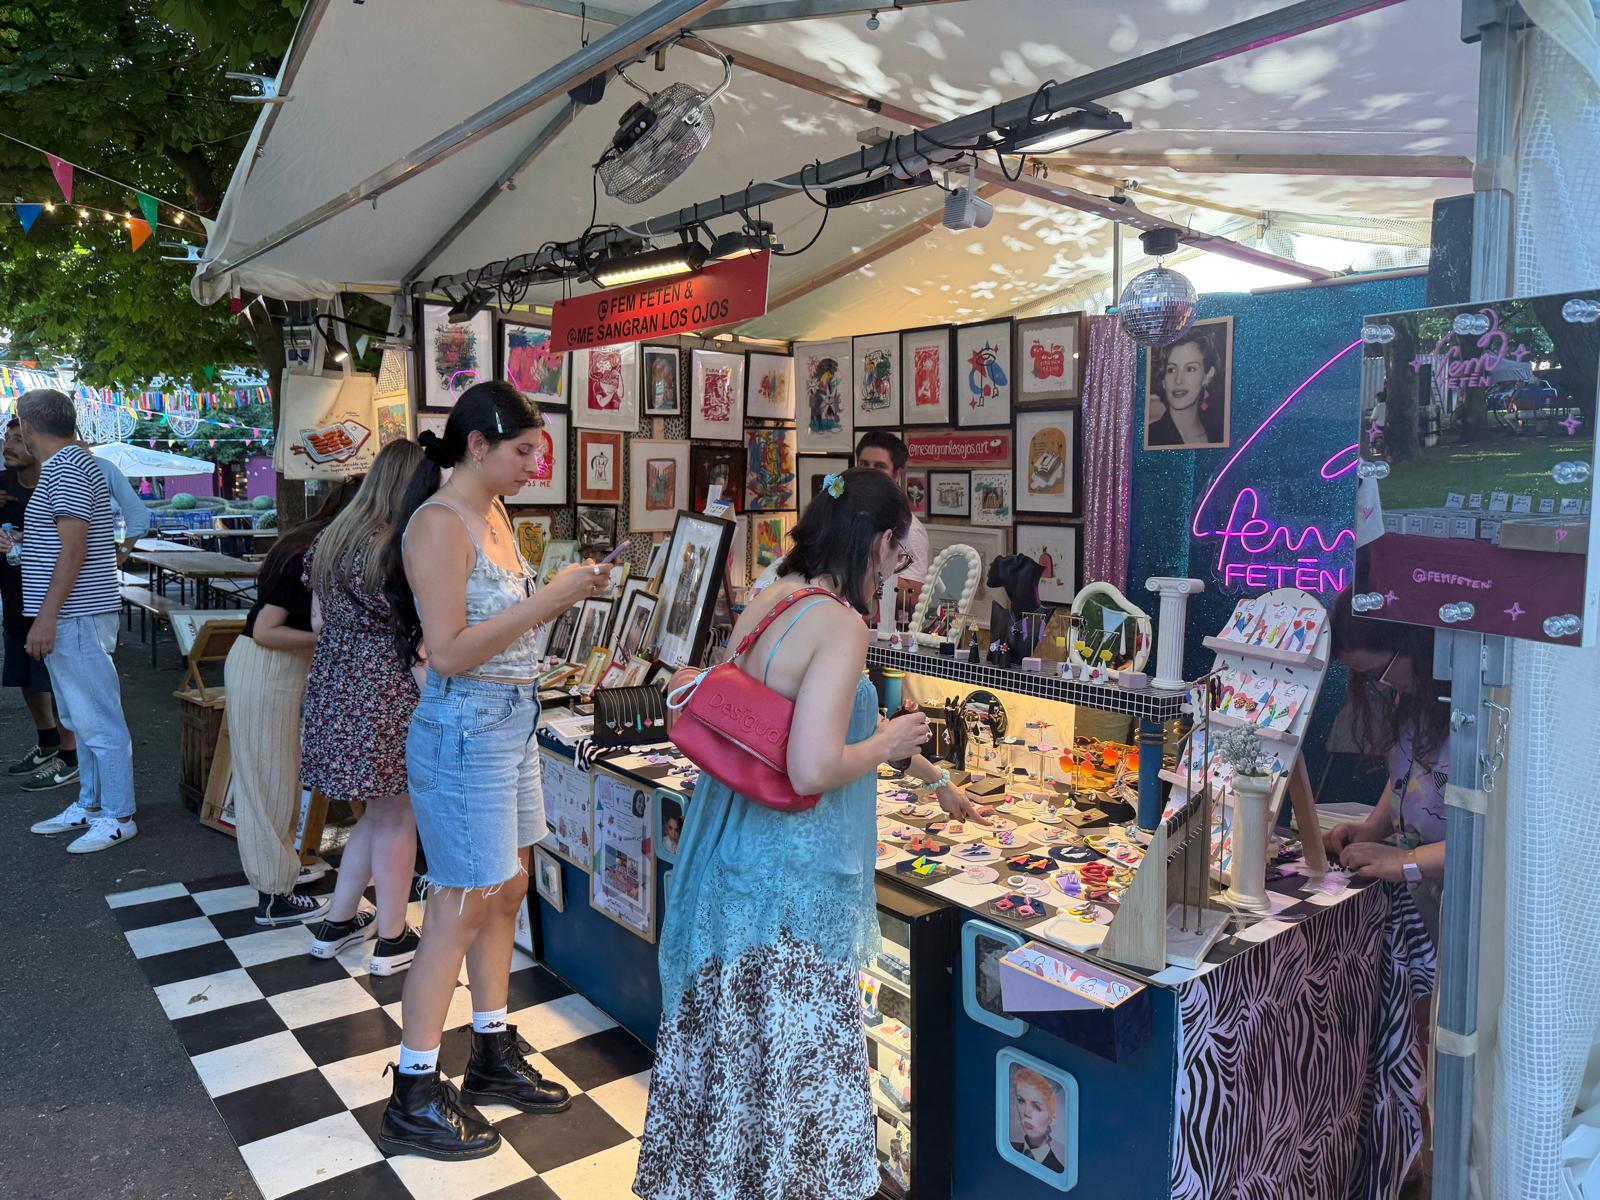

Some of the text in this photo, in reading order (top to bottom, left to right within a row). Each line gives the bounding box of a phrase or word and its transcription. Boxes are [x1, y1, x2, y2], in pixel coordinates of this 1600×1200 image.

[639, 284, 681, 309] FETEN
[684, 280, 694, 300] &
[566, 299, 729, 346] @ME SANGRAN LOS OJOS
[708, 693, 788, 750] Desigual
